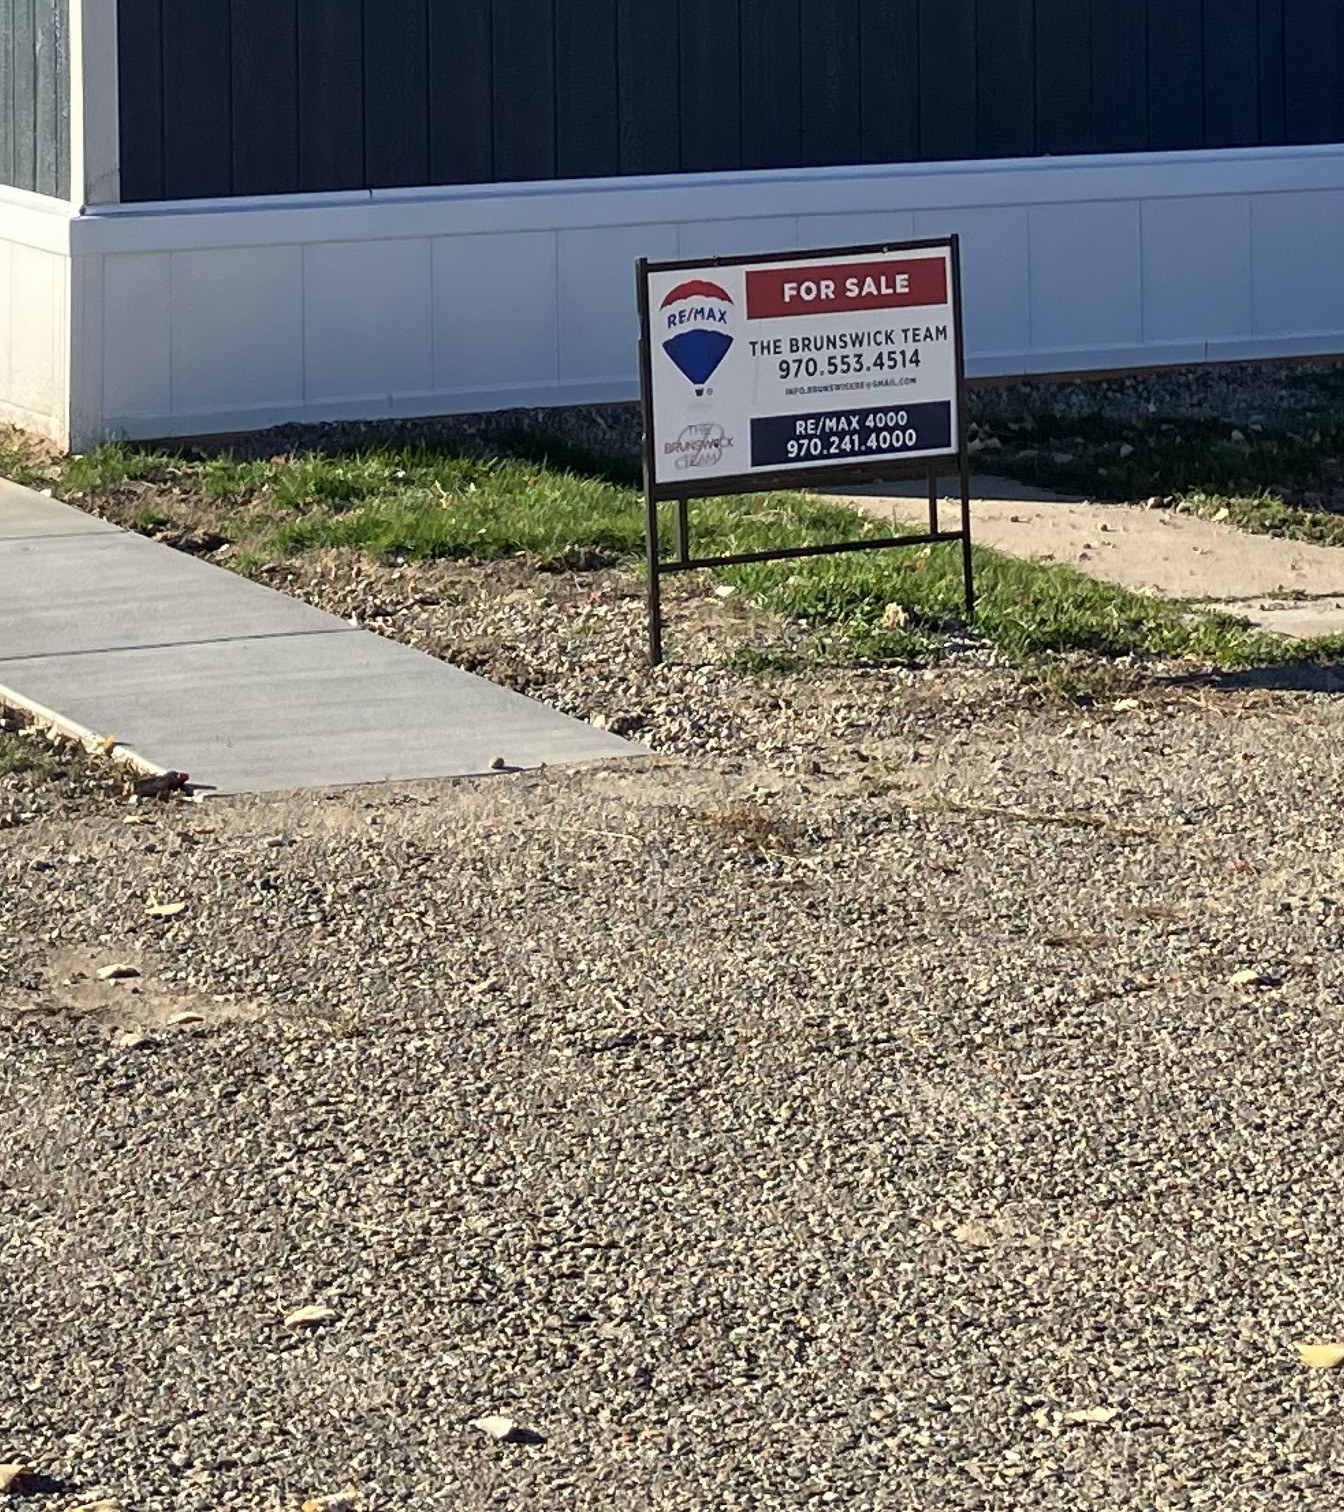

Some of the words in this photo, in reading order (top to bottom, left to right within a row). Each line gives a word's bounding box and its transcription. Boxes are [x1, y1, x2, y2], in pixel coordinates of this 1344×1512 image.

[783, 279, 835, 303] FOR
[845, 274, 910, 298] SALE
[667, 308, 728, 329] RE/MAX
[749, 338, 783, 357] THE
[789, 329, 896, 354] BRUNSWICK
[901, 325, 948, 344] TEAM
[778, 348, 922, 379] 970.553.4514
[795, 416, 860, 436] RE/MAX
[865, 410, 908, 429] 4000
[786, 428, 918, 458] 970.241.4000
